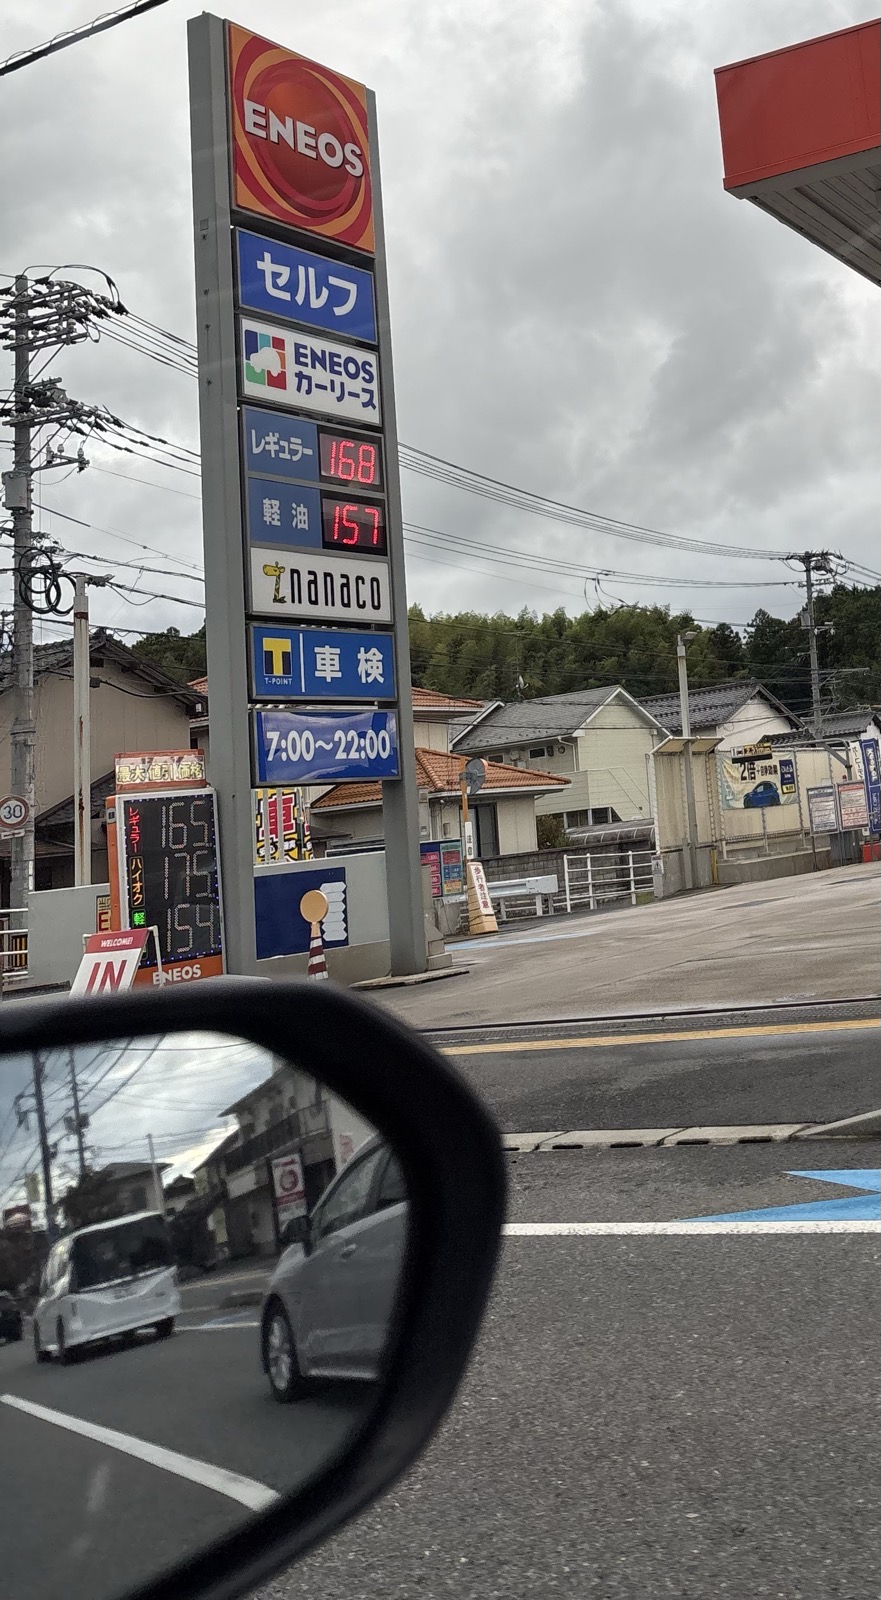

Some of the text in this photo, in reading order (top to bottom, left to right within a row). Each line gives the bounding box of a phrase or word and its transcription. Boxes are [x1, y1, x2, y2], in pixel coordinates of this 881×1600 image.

[243, 98, 364, 178] ENEOS
[256, 251, 358, 317] セルフ
[294, 342, 375, 384] ENEOS
[294, 370, 377, 410] カーリース
[251, 429, 376, 484] レギュラー 168
[262, 498, 379, 545] 軽油 157
[289, 567, 382, 611] nanaco
[264, 677, 293, 686] T-POINT
[314, 645, 385, 684] 車検
[3, 804, 23, 820] 30
[128, 806, 141, 853] レギュラー
[161, 800, 208, 850] 165
[131, 857, 143, 906] ハイオク
[163, 850, 211, 900] 175
[100, 936, 134, 948] WELCOME!
[166, 902, 214, 953] 154
[84, 959, 128, 995] IN
[152, 964, 202, 985] ENEOS
